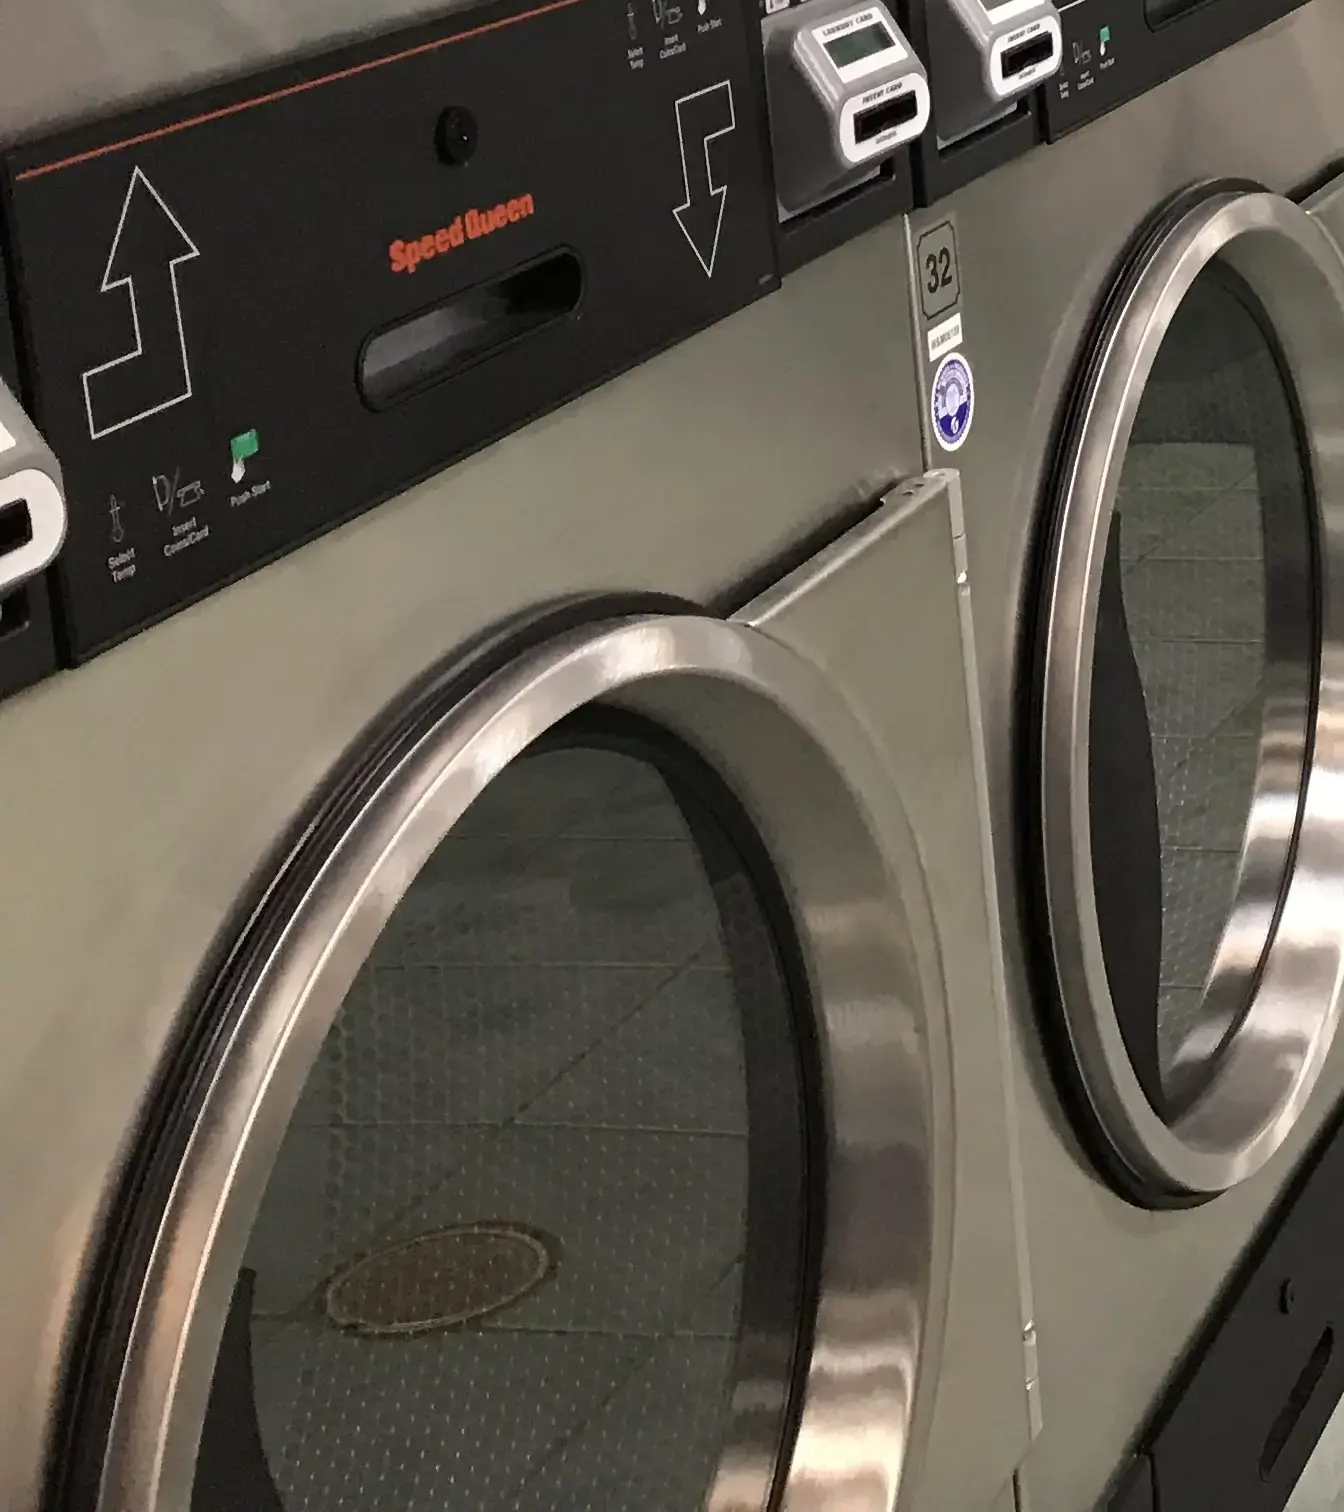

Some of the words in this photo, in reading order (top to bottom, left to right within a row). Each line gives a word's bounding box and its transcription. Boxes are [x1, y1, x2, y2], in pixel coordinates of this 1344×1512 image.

[389, 215, 465, 274] Speed
[464, 193, 535, 240] Queen
[926, 246, 953, 294] 32
